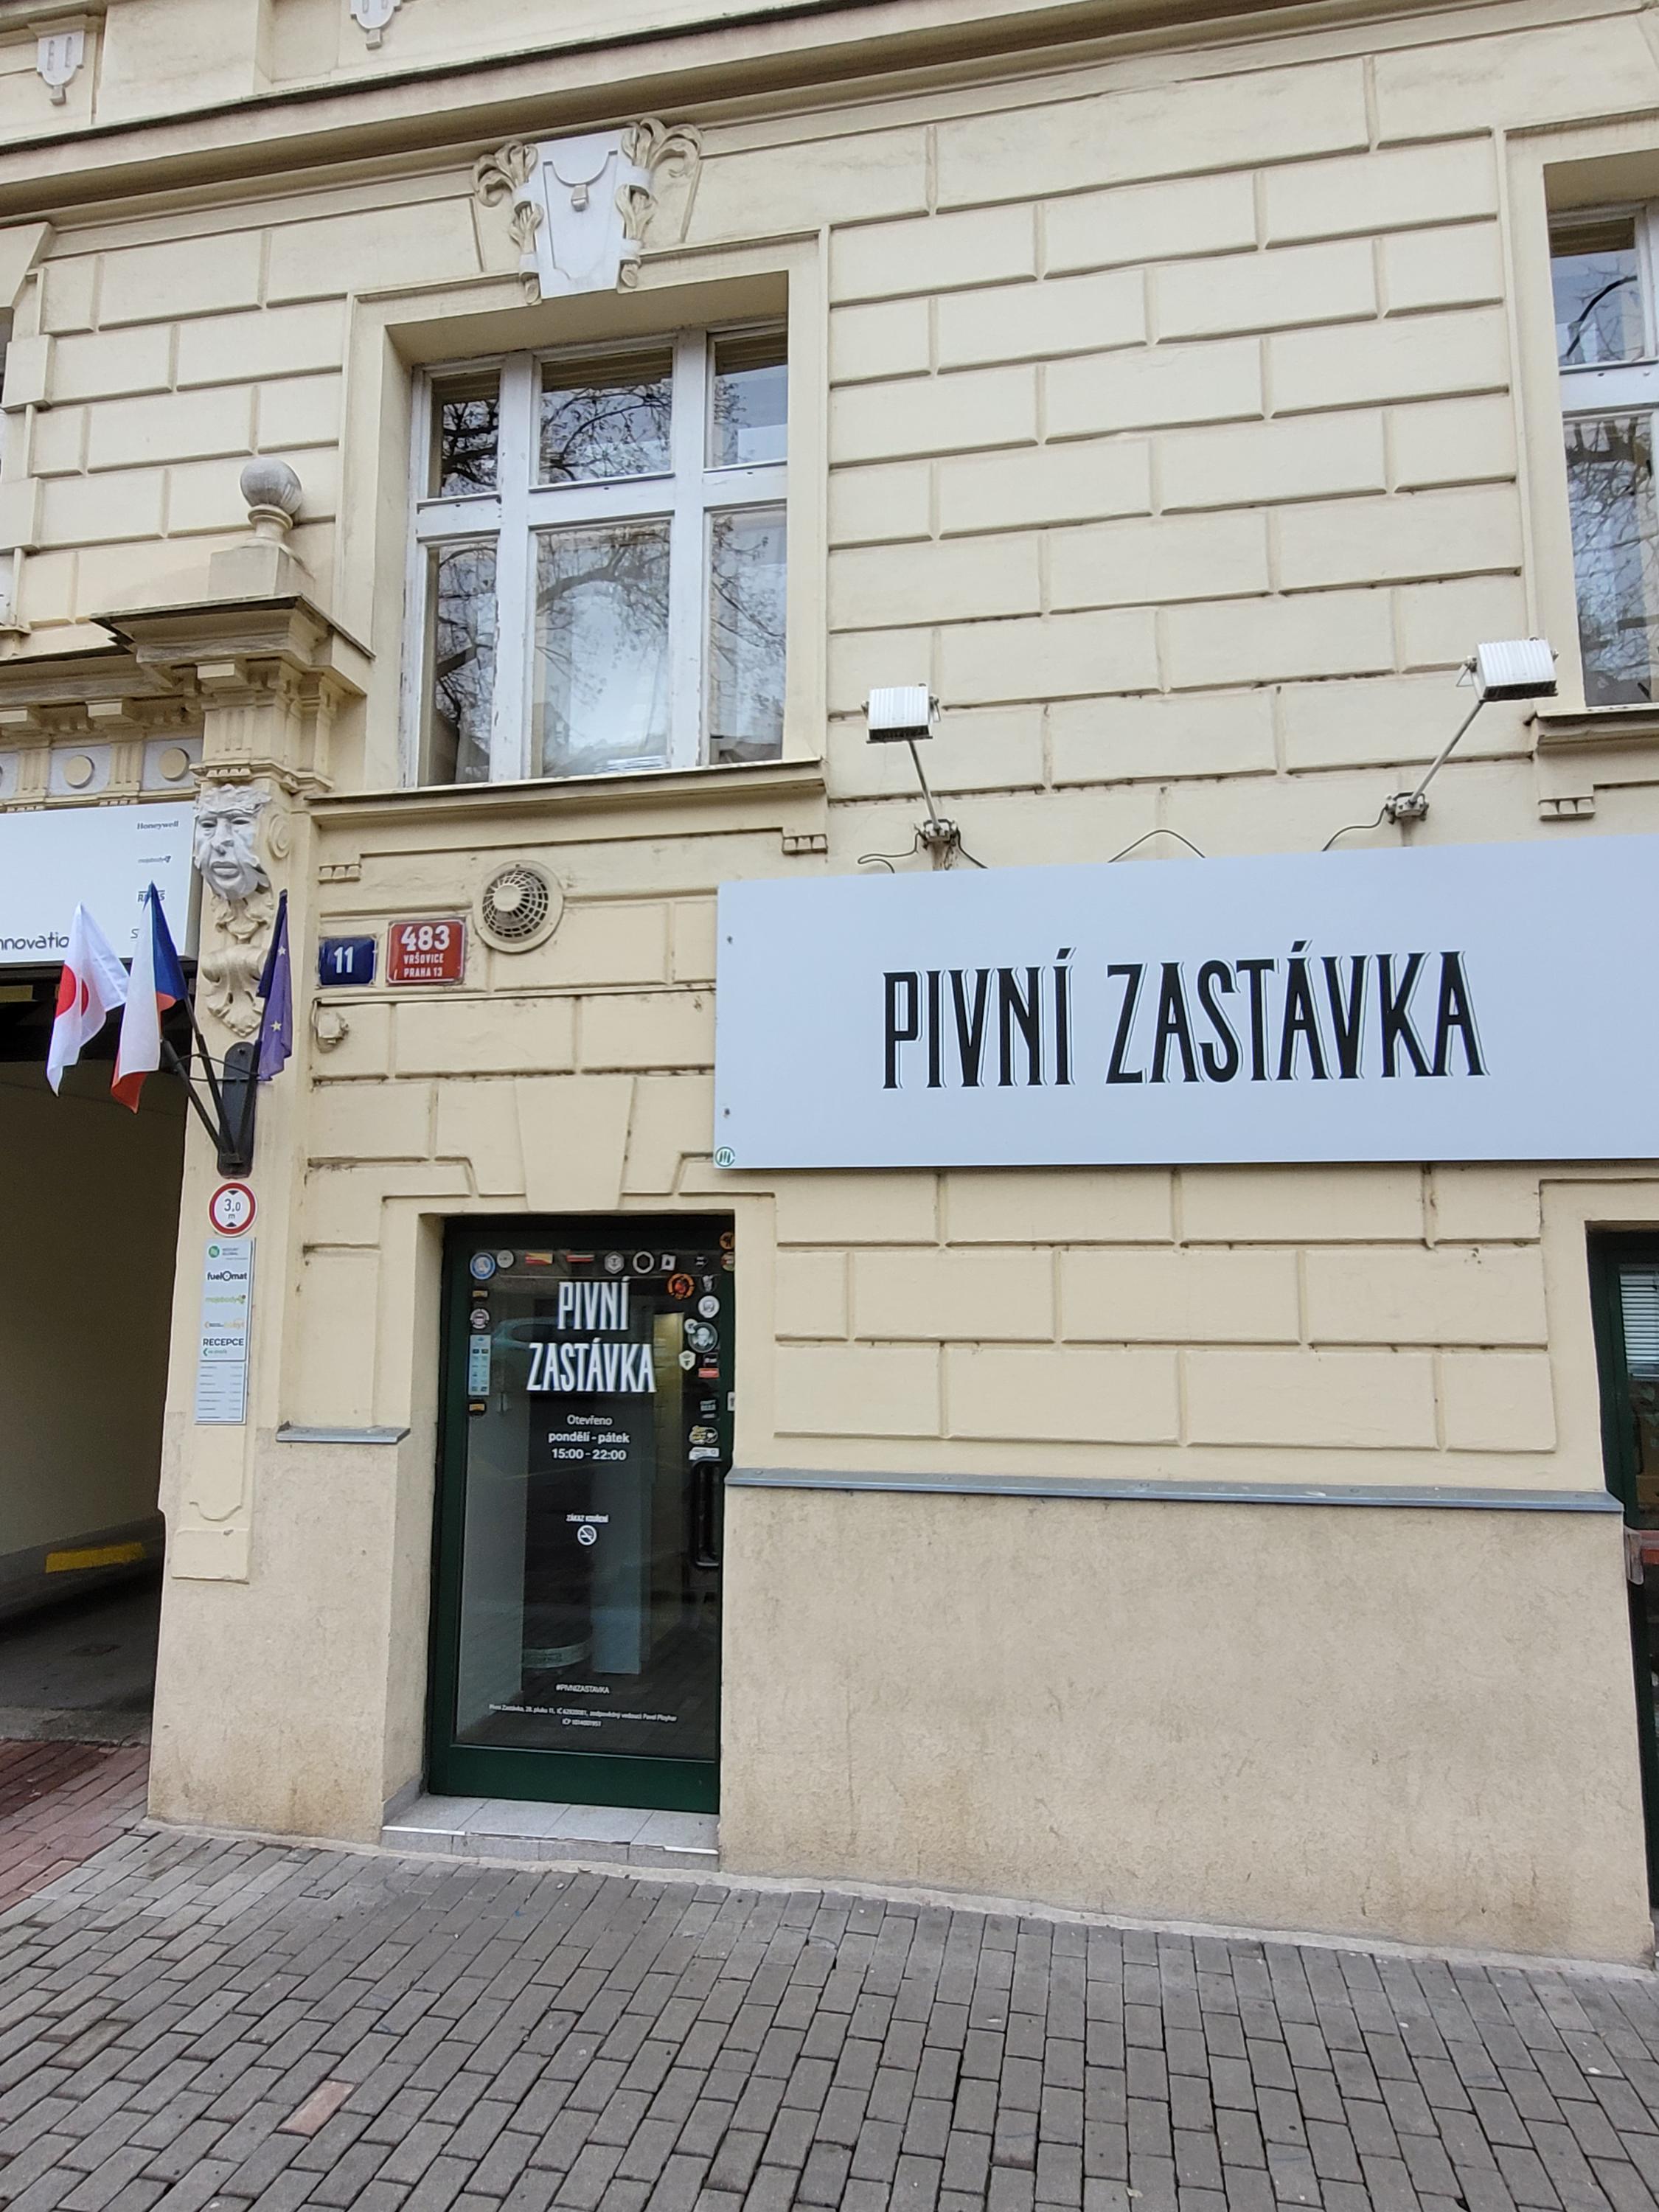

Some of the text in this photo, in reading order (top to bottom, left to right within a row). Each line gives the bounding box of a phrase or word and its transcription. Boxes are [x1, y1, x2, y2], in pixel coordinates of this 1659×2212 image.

[137, 821, 179, 830] Honeywell
[401, 925, 450, 951] 483
[334, 947, 353, 973] 11
[404, 953, 444, 964] VRŠOVICE
[404, 966, 442, 978] PRAHA 13
[883, 939, 1490, 1090] PIVNÍ ZASTÁVKA
[557, 1276, 630, 1330] PIVNÍ
[203, 1338, 245, 1346] RECEPCE
[526, 1337, 657, 1393] ZASTÁVKA
[566, 1414, 613, 1426] Otevřeno
[548, 1431, 591, 1443] pondělí
[597, 1432, 630, 1444] pátek
[552, 1448, 584, 1459] 15:00
[592, 1449, 627, 1461] 22:00
